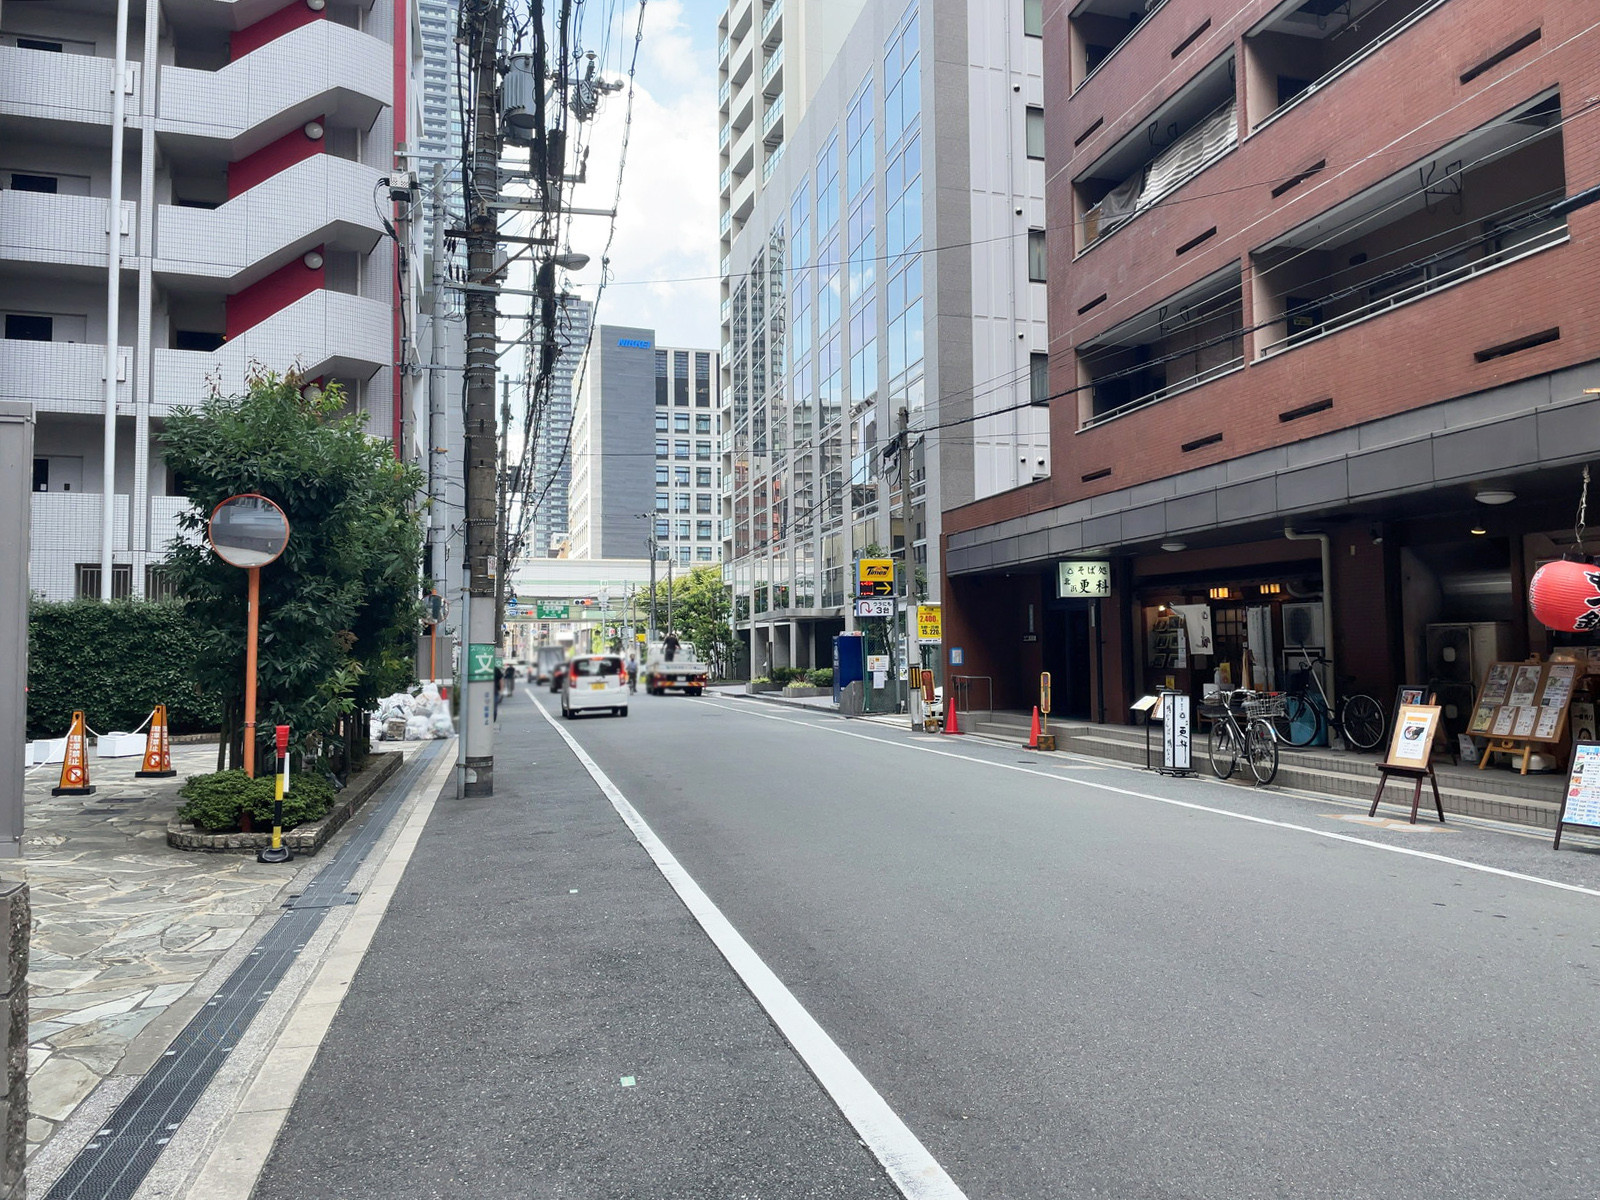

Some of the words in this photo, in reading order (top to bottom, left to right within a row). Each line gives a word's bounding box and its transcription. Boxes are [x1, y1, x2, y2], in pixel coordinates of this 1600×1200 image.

[617, 338, 651, 349] NIKKEI
[866, 566, 889, 576] Times
[1078, 565, 1108, 575] そば処
[1080, 579, 1109, 593] 更科
[475, 653, 494, 674] 文
